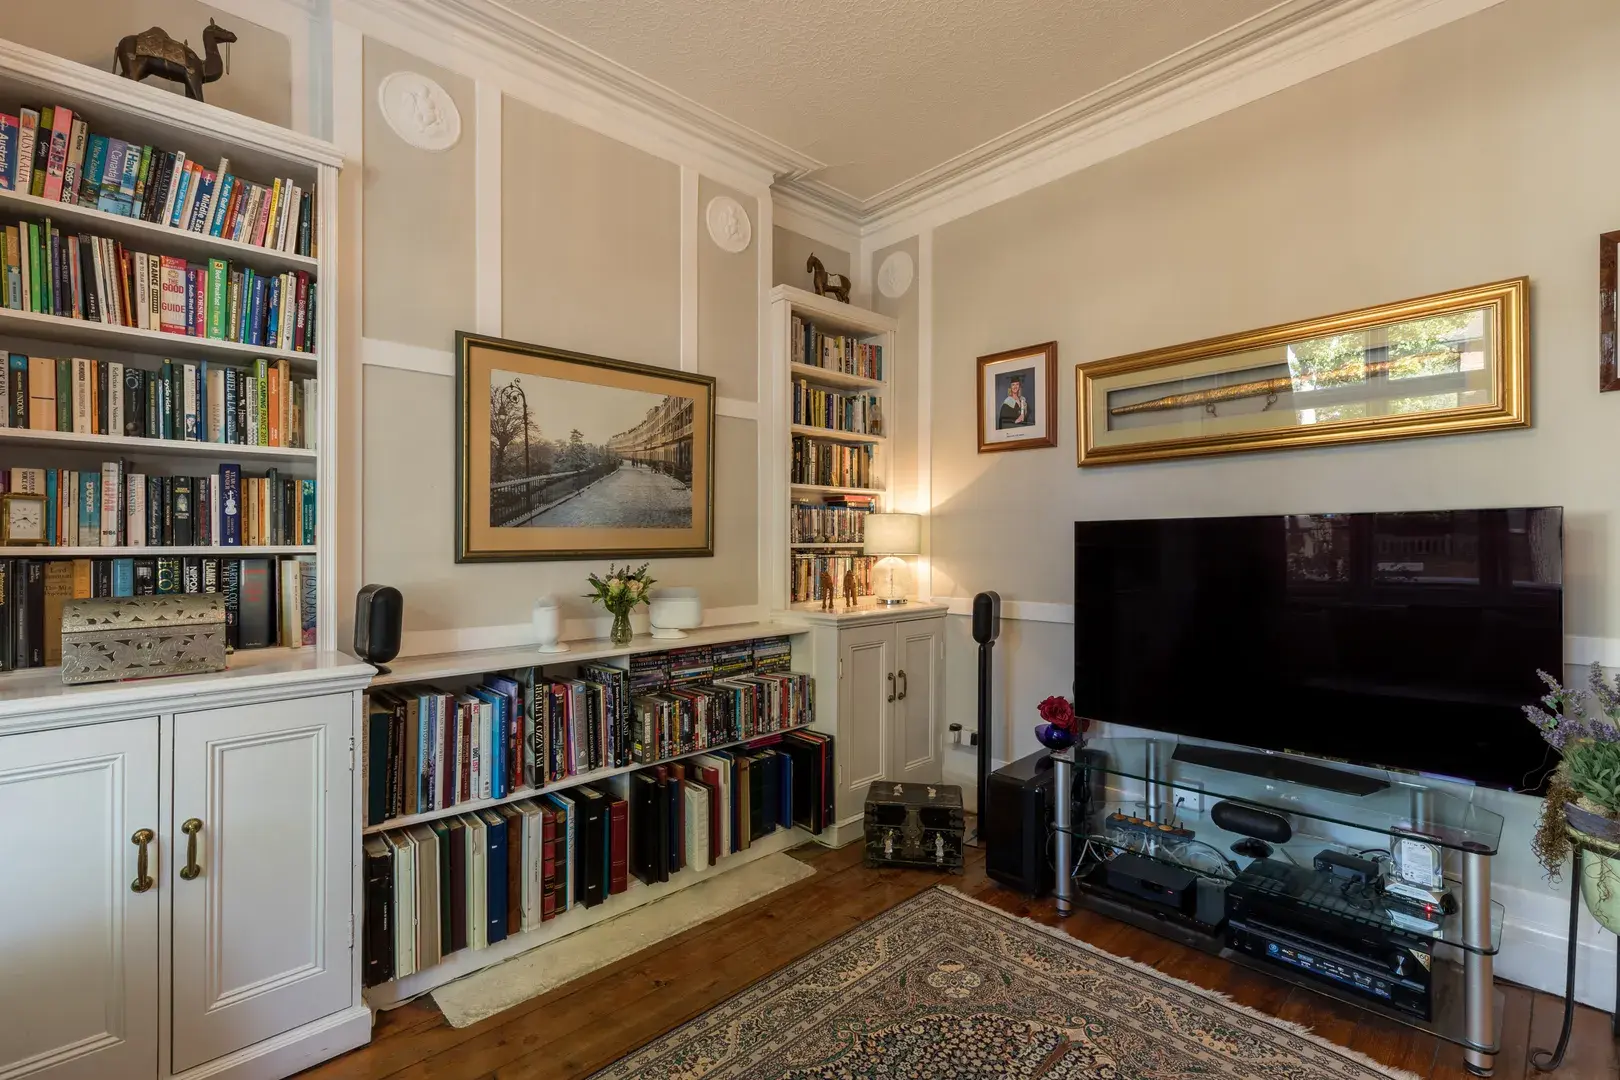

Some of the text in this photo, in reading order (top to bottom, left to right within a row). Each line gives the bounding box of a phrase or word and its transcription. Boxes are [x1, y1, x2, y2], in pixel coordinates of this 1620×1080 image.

[0, 134, 9, 172] Australia
[19, 132, 32, 183] AUSTRALIA
[88, 146, 100, 180] New Zealand
[108, 150, 122, 178] Canada
[159, 168, 171, 203] MALAYSIA
[198, 194, 210, 218] Middle
[215, 184, 230, 225] Arab Gulf States
[162, 283, 184, 294] GOOD
[162, 302, 185, 313] GUIDE
[227, 370, 235, 392] HOTEL
[227, 401, 235, 414] LAC
[104, 481, 115, 512] JAPAN
[158, 561, 173, 590] ECO
[206, 562, 216, 585] FLAMES
[229, 562, 237, 591] MARTINA
[302, 575, 316, 623] LONDON
